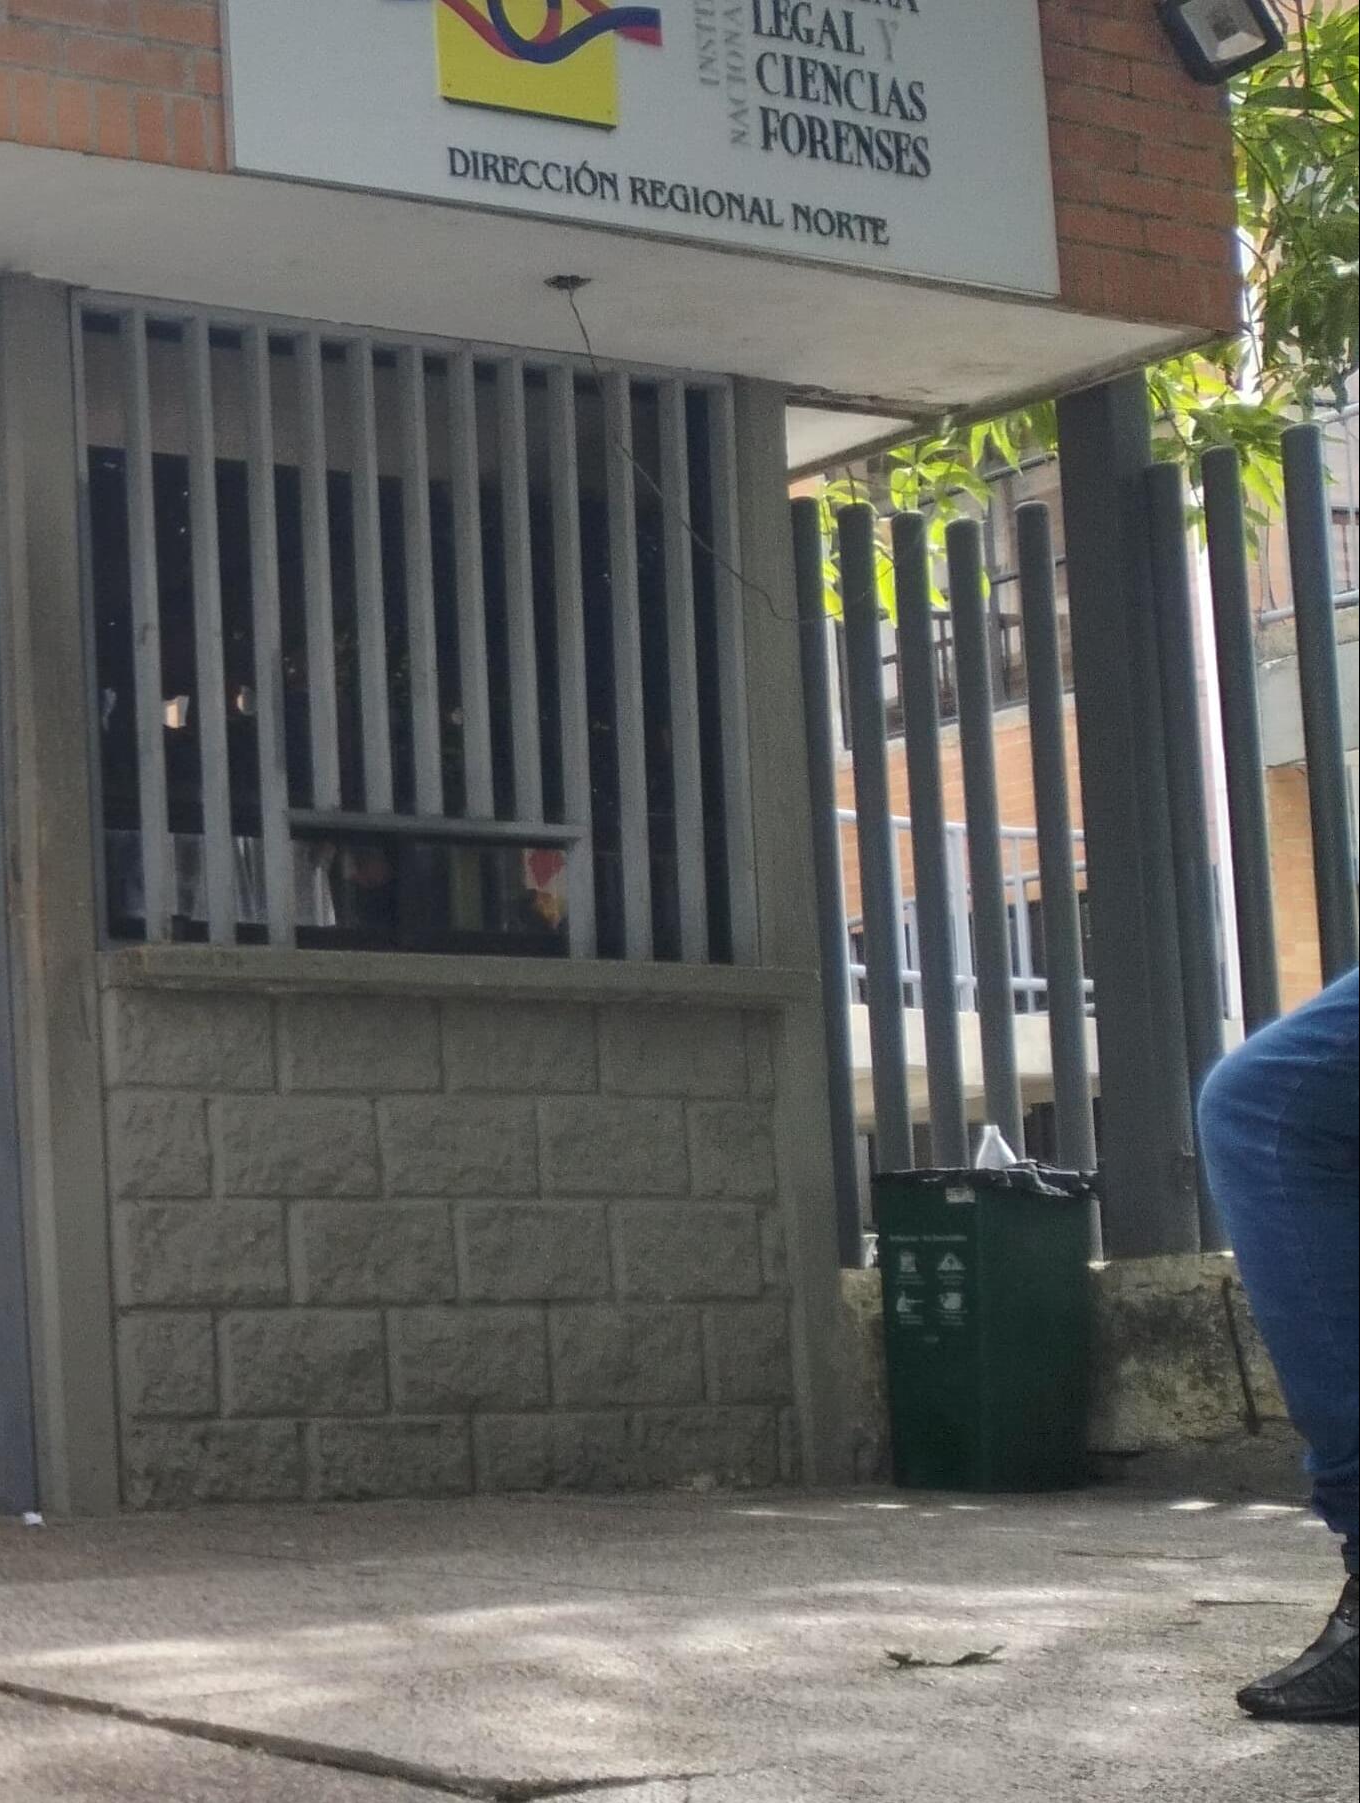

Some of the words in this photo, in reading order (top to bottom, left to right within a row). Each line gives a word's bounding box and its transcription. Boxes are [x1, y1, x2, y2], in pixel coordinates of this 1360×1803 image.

[753, 0, 865, 55] LEGAL
[876, 17, 899, 63] Y
[723, 2, 751, 147] NACIONA
[756, 52, 928, 122] CIENCIAS
[759, 106, 931, 178] FORENSES
[447, 146, 619, 201] DIRECCIÓN
[629, 176, 783, 227] REGIONAL
[791, 203, 890, 246] NORTE
